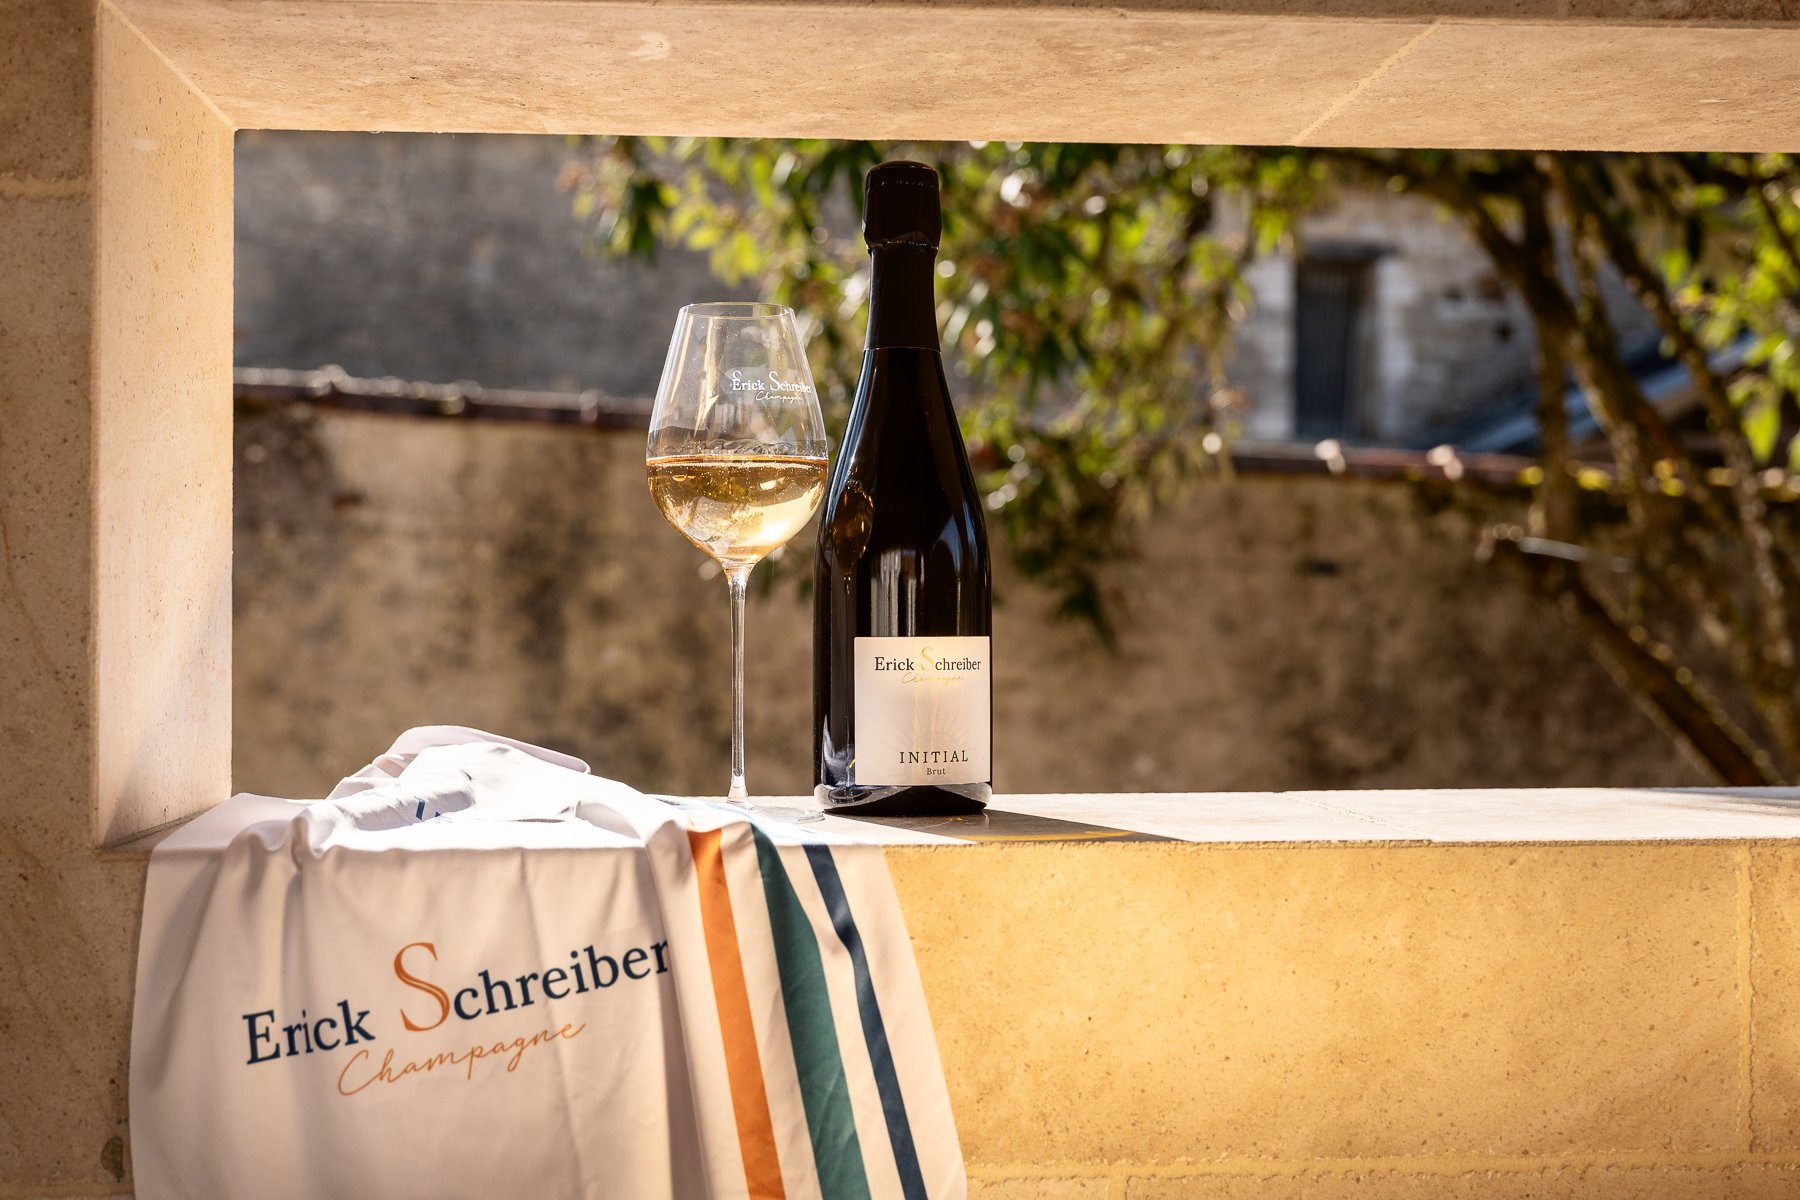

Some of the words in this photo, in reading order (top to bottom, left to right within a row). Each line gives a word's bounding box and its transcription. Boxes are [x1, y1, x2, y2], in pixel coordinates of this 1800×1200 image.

[731, 379, 766, 391] Erick
[874, 656, 915, 671] Erick
[920, 646, 982, 672] Schreiber
[901, 671, 964, 687] Champagne
[899, 750, 969, 764] INITIAL
[926, 767, 947, 776] Brut
[242, 999, 376, 1064] Erick
[393, 940, 669, 1032] Schreiber
[338, 1022, 586, 1096] Champagne
